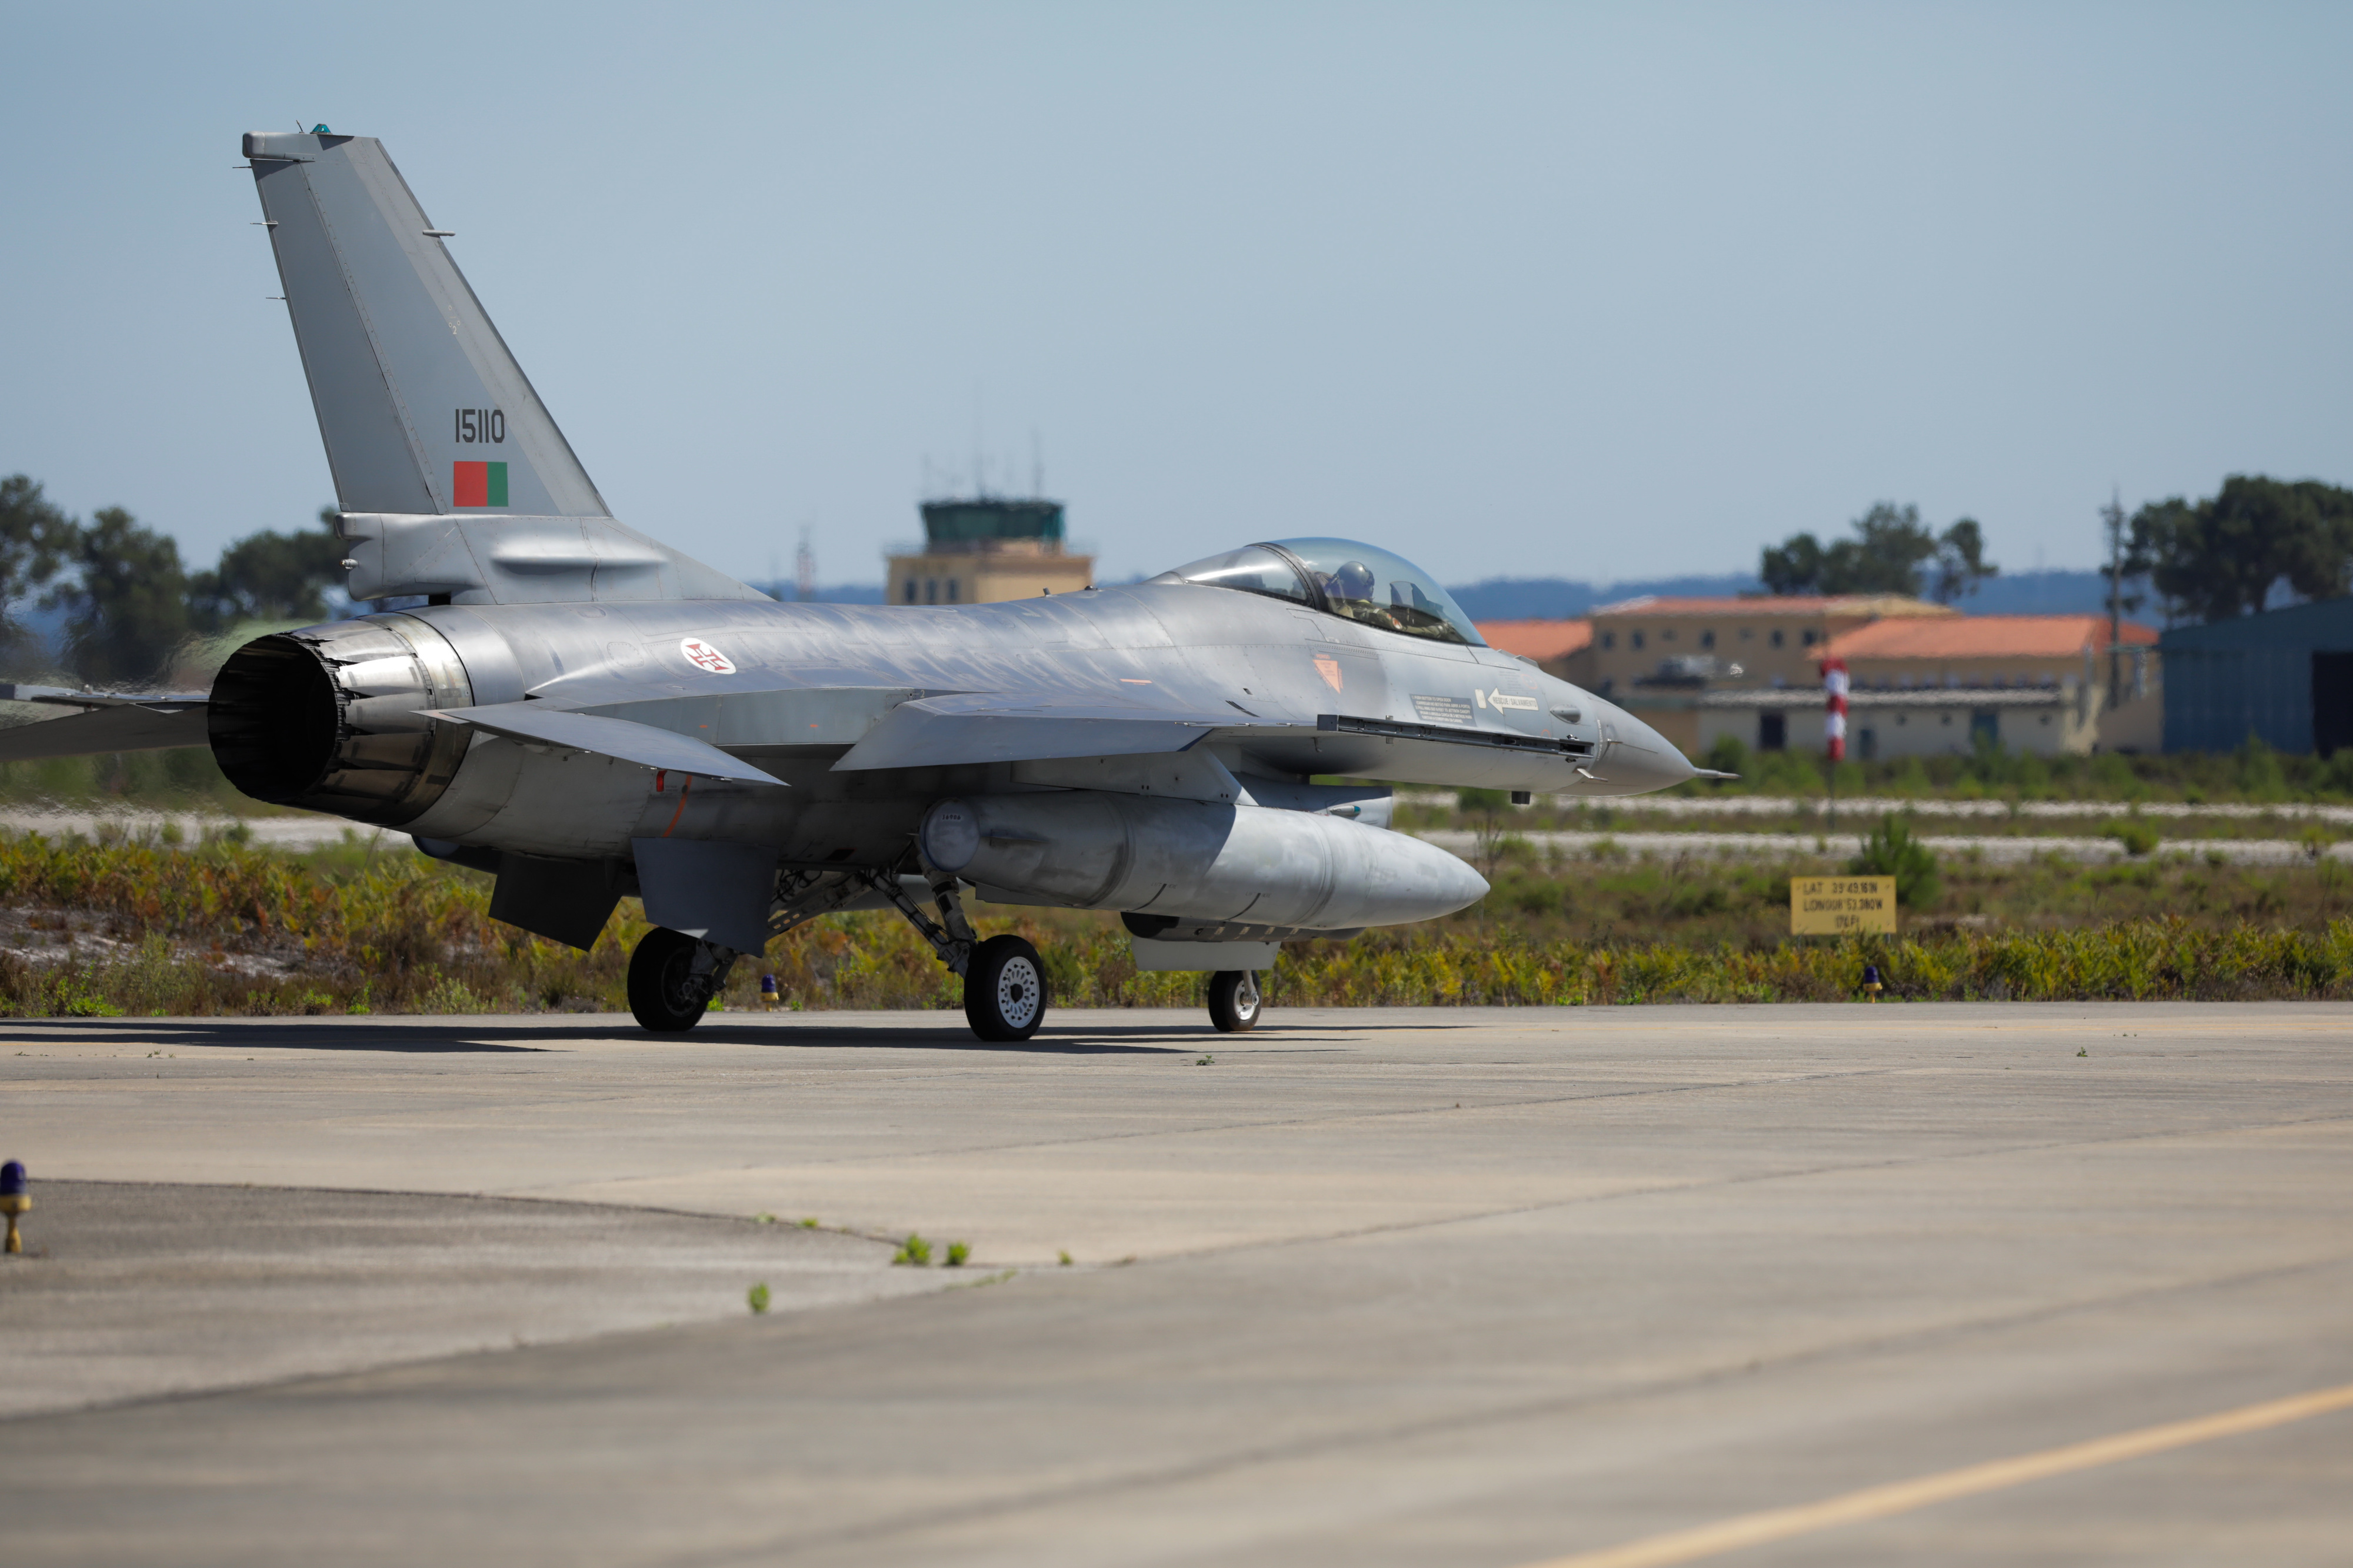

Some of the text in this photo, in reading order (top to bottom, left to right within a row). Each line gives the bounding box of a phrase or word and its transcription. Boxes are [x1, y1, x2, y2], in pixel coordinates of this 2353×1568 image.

[452, 325, 457, 335] 2
[455, 409, 505, 443] 15110
[920, 689, 925, 698] 2
[1492, 696, 1508, 705] RESCUE
[1511, 698, 1537, 708] SALVAMENTO
